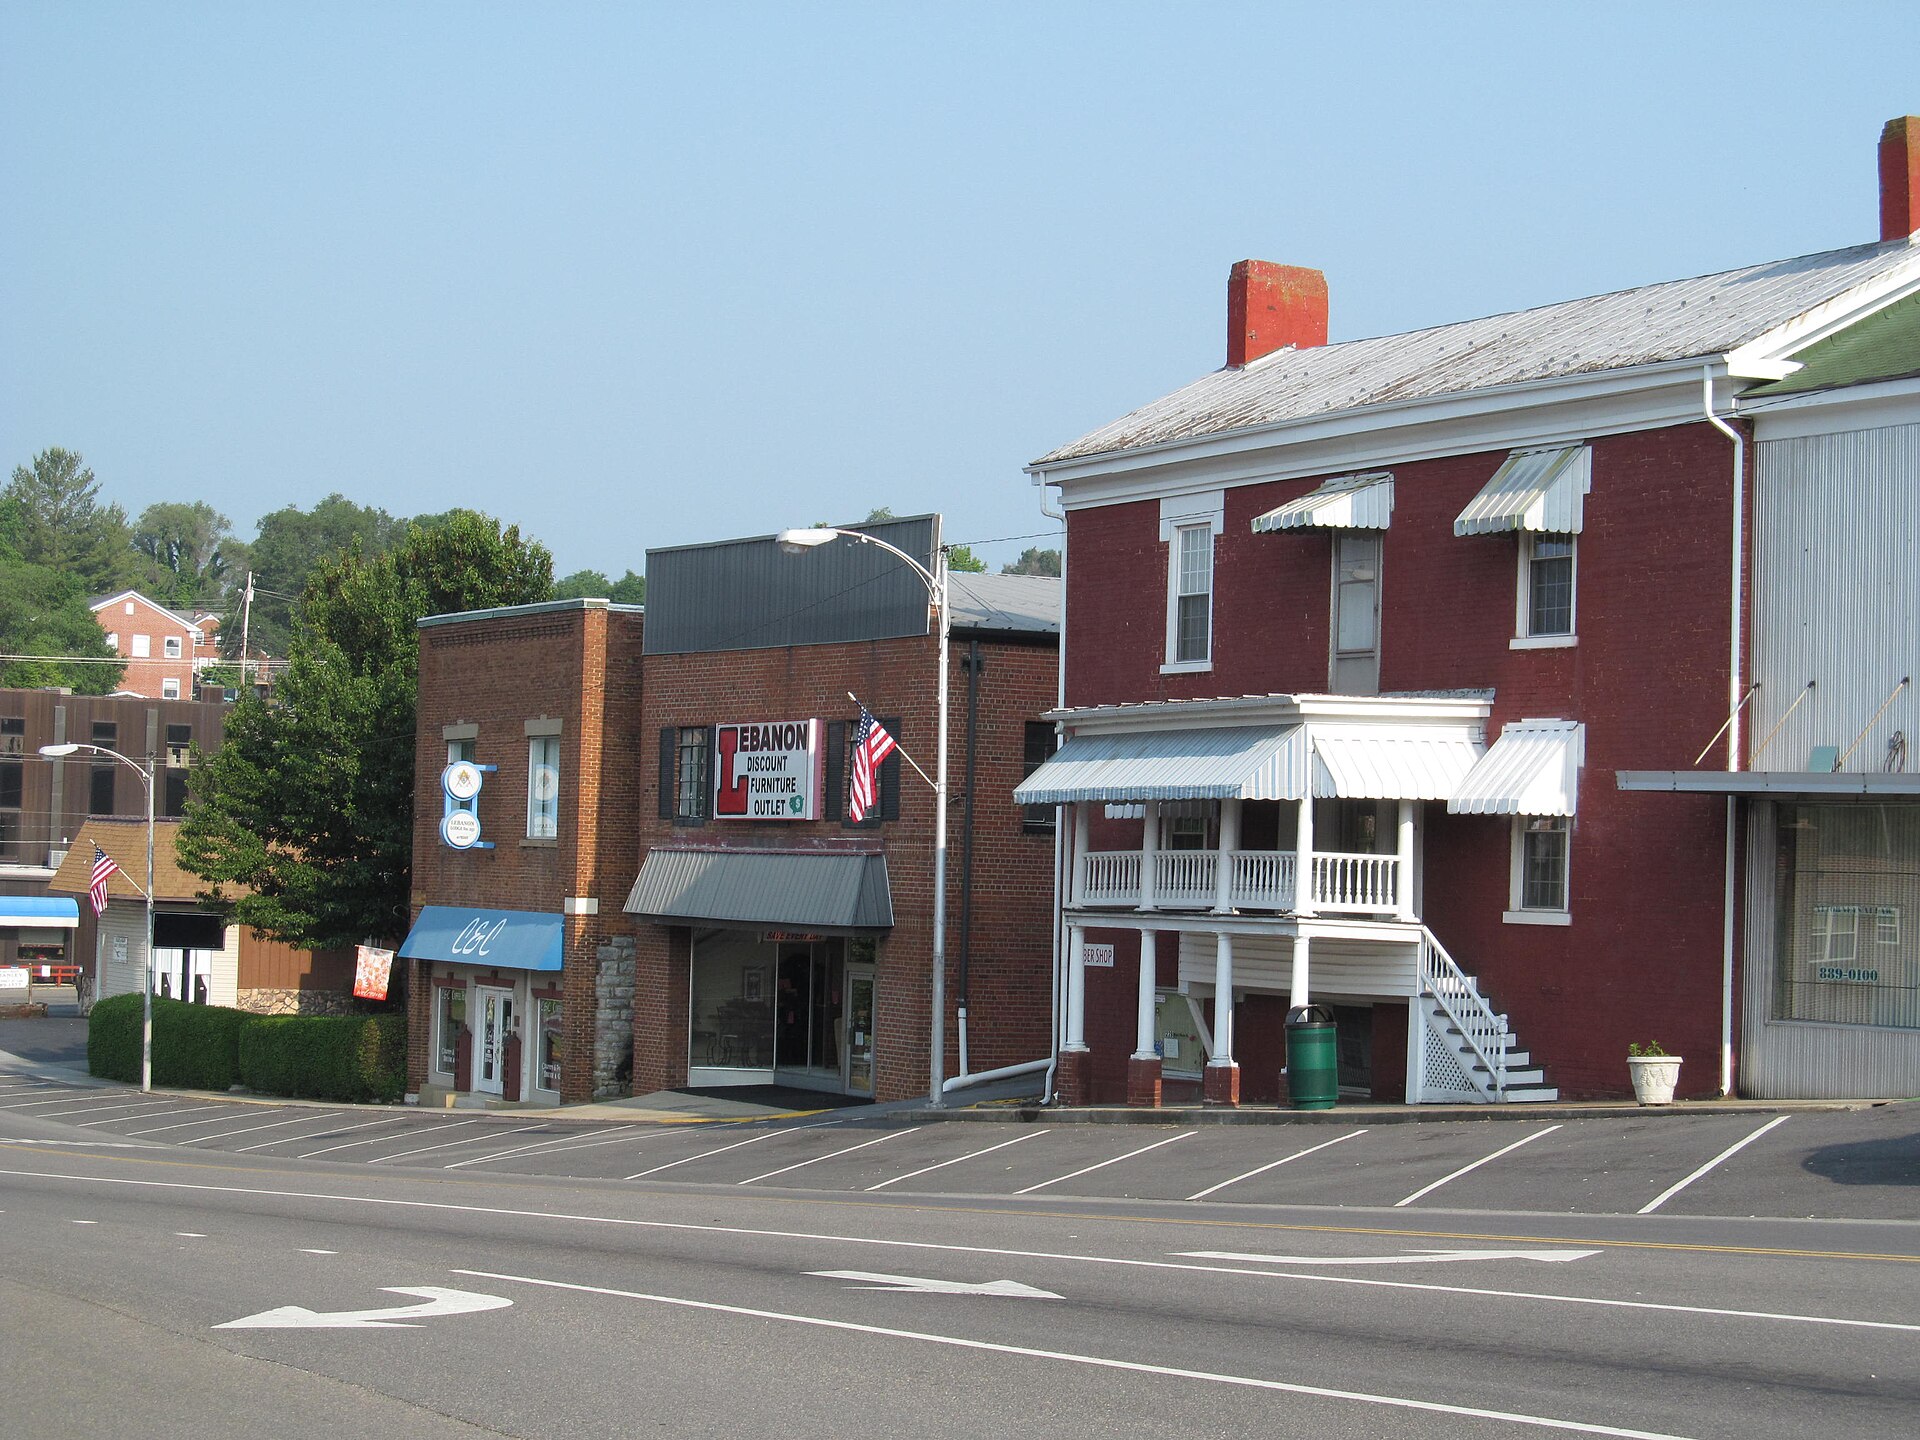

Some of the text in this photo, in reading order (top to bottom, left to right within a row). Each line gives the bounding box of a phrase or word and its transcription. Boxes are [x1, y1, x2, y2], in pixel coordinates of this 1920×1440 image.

[717, 723, 807, 815] LEBANON
[747, 755, 787, 772] DISCOUNT
[750, 777, 797, 793] FURNITURE
[754, 799, 786, 815] OUTLET
[452, 917, 507, 956] C&C
[1096, 948, 1112, 963] SHOP
[1820, 967, 1878, 981] 889-0100
